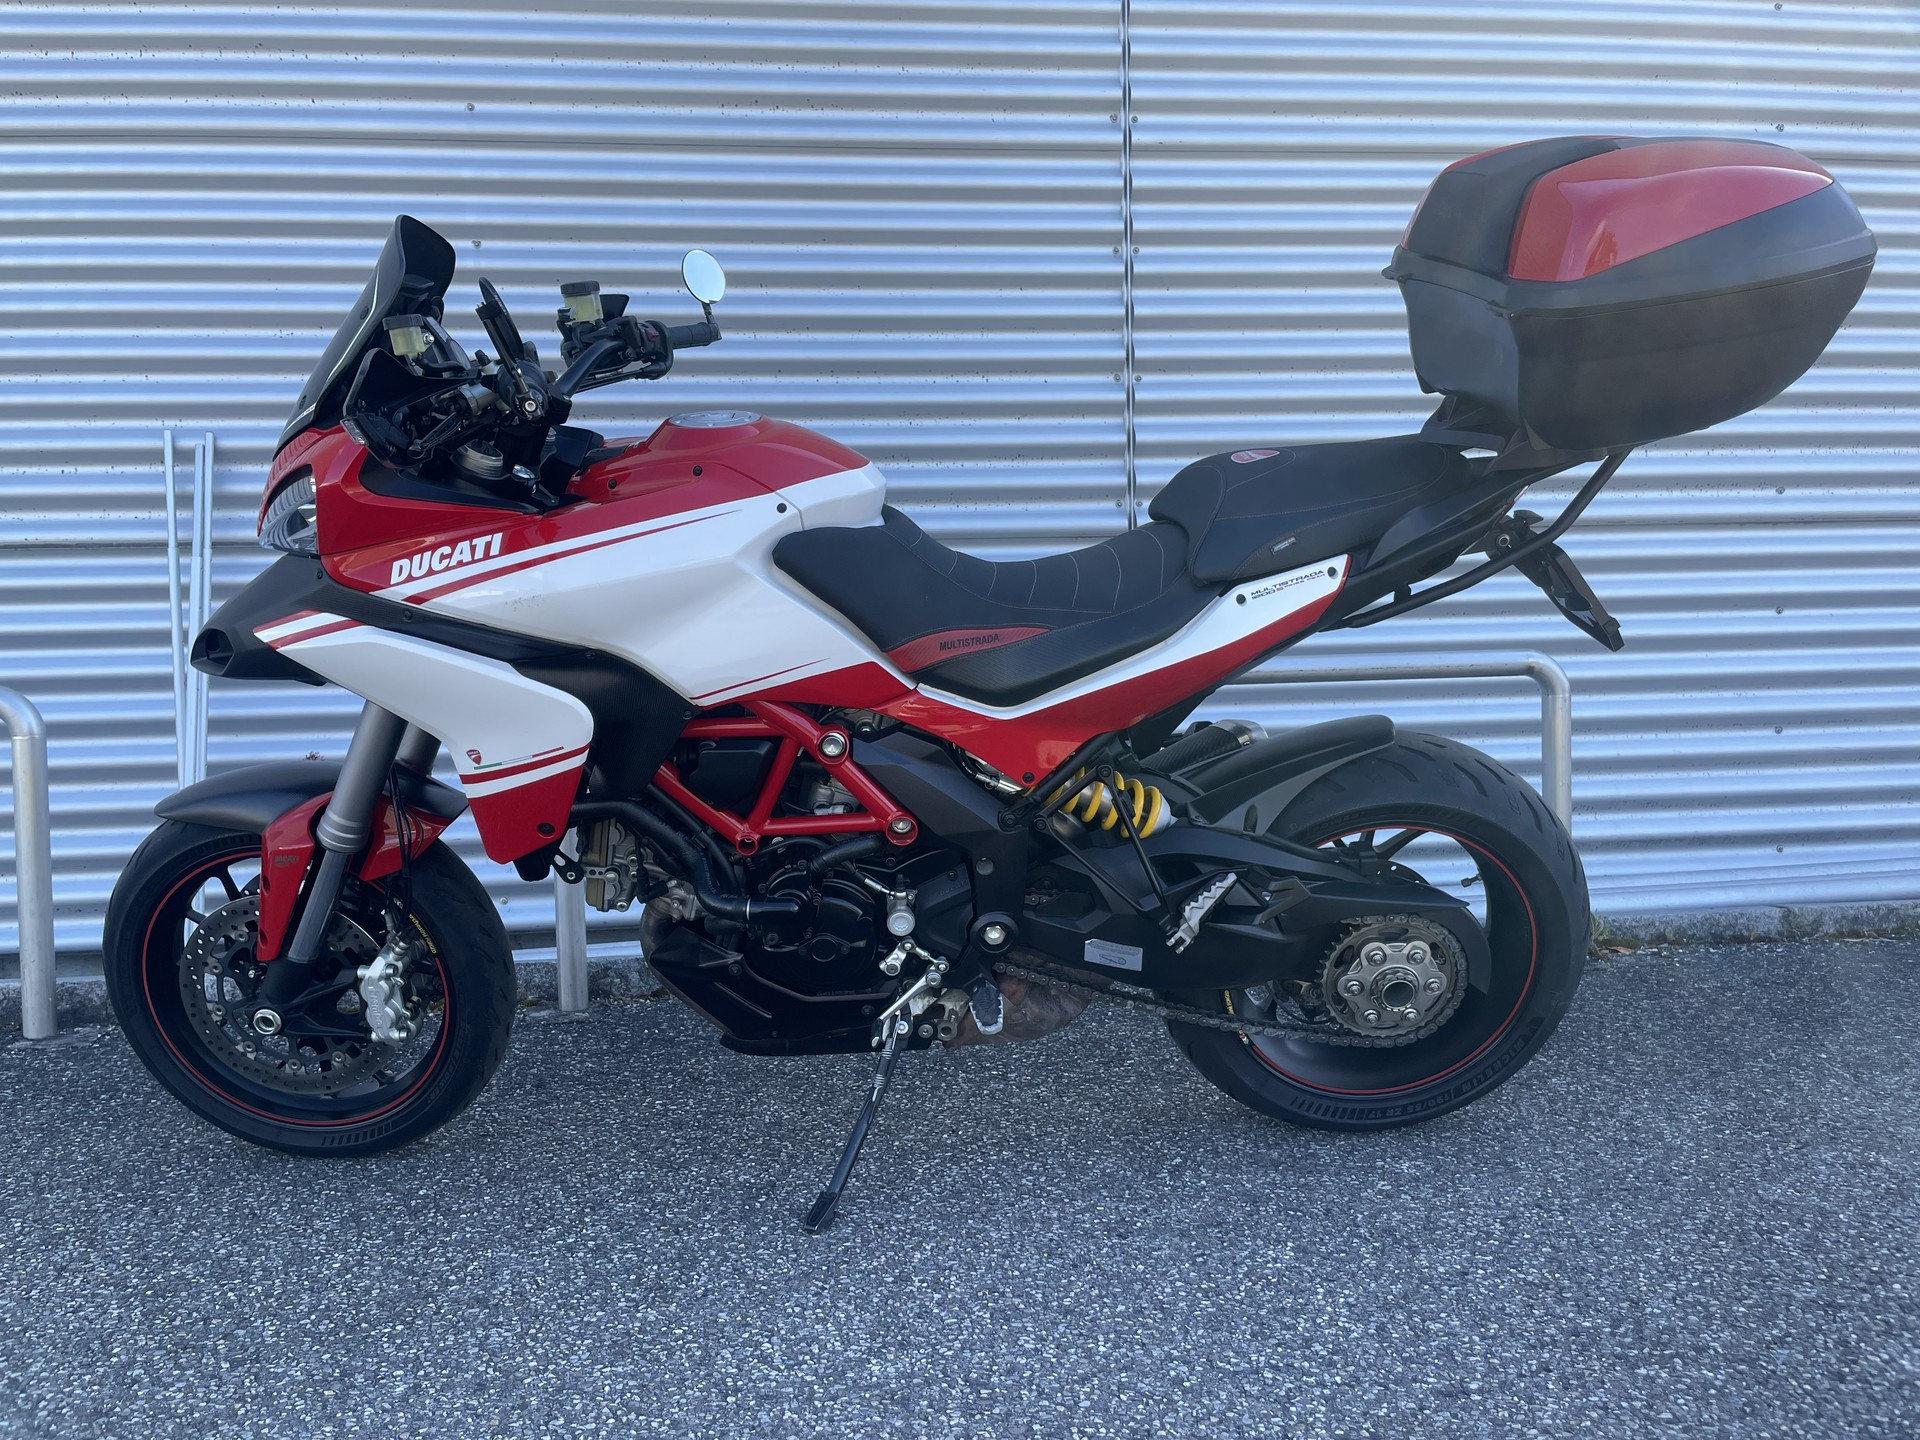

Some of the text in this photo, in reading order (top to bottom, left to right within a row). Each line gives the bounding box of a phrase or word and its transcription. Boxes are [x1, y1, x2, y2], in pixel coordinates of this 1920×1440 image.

[390, 532, 503, 585] DUCATI
[1250, 570, 1324, 596] MULTISTRADA
[939, 633, 1000, 651] MULTISTRADA
[1462, 1037, 1526, 1093] MICHELIN
